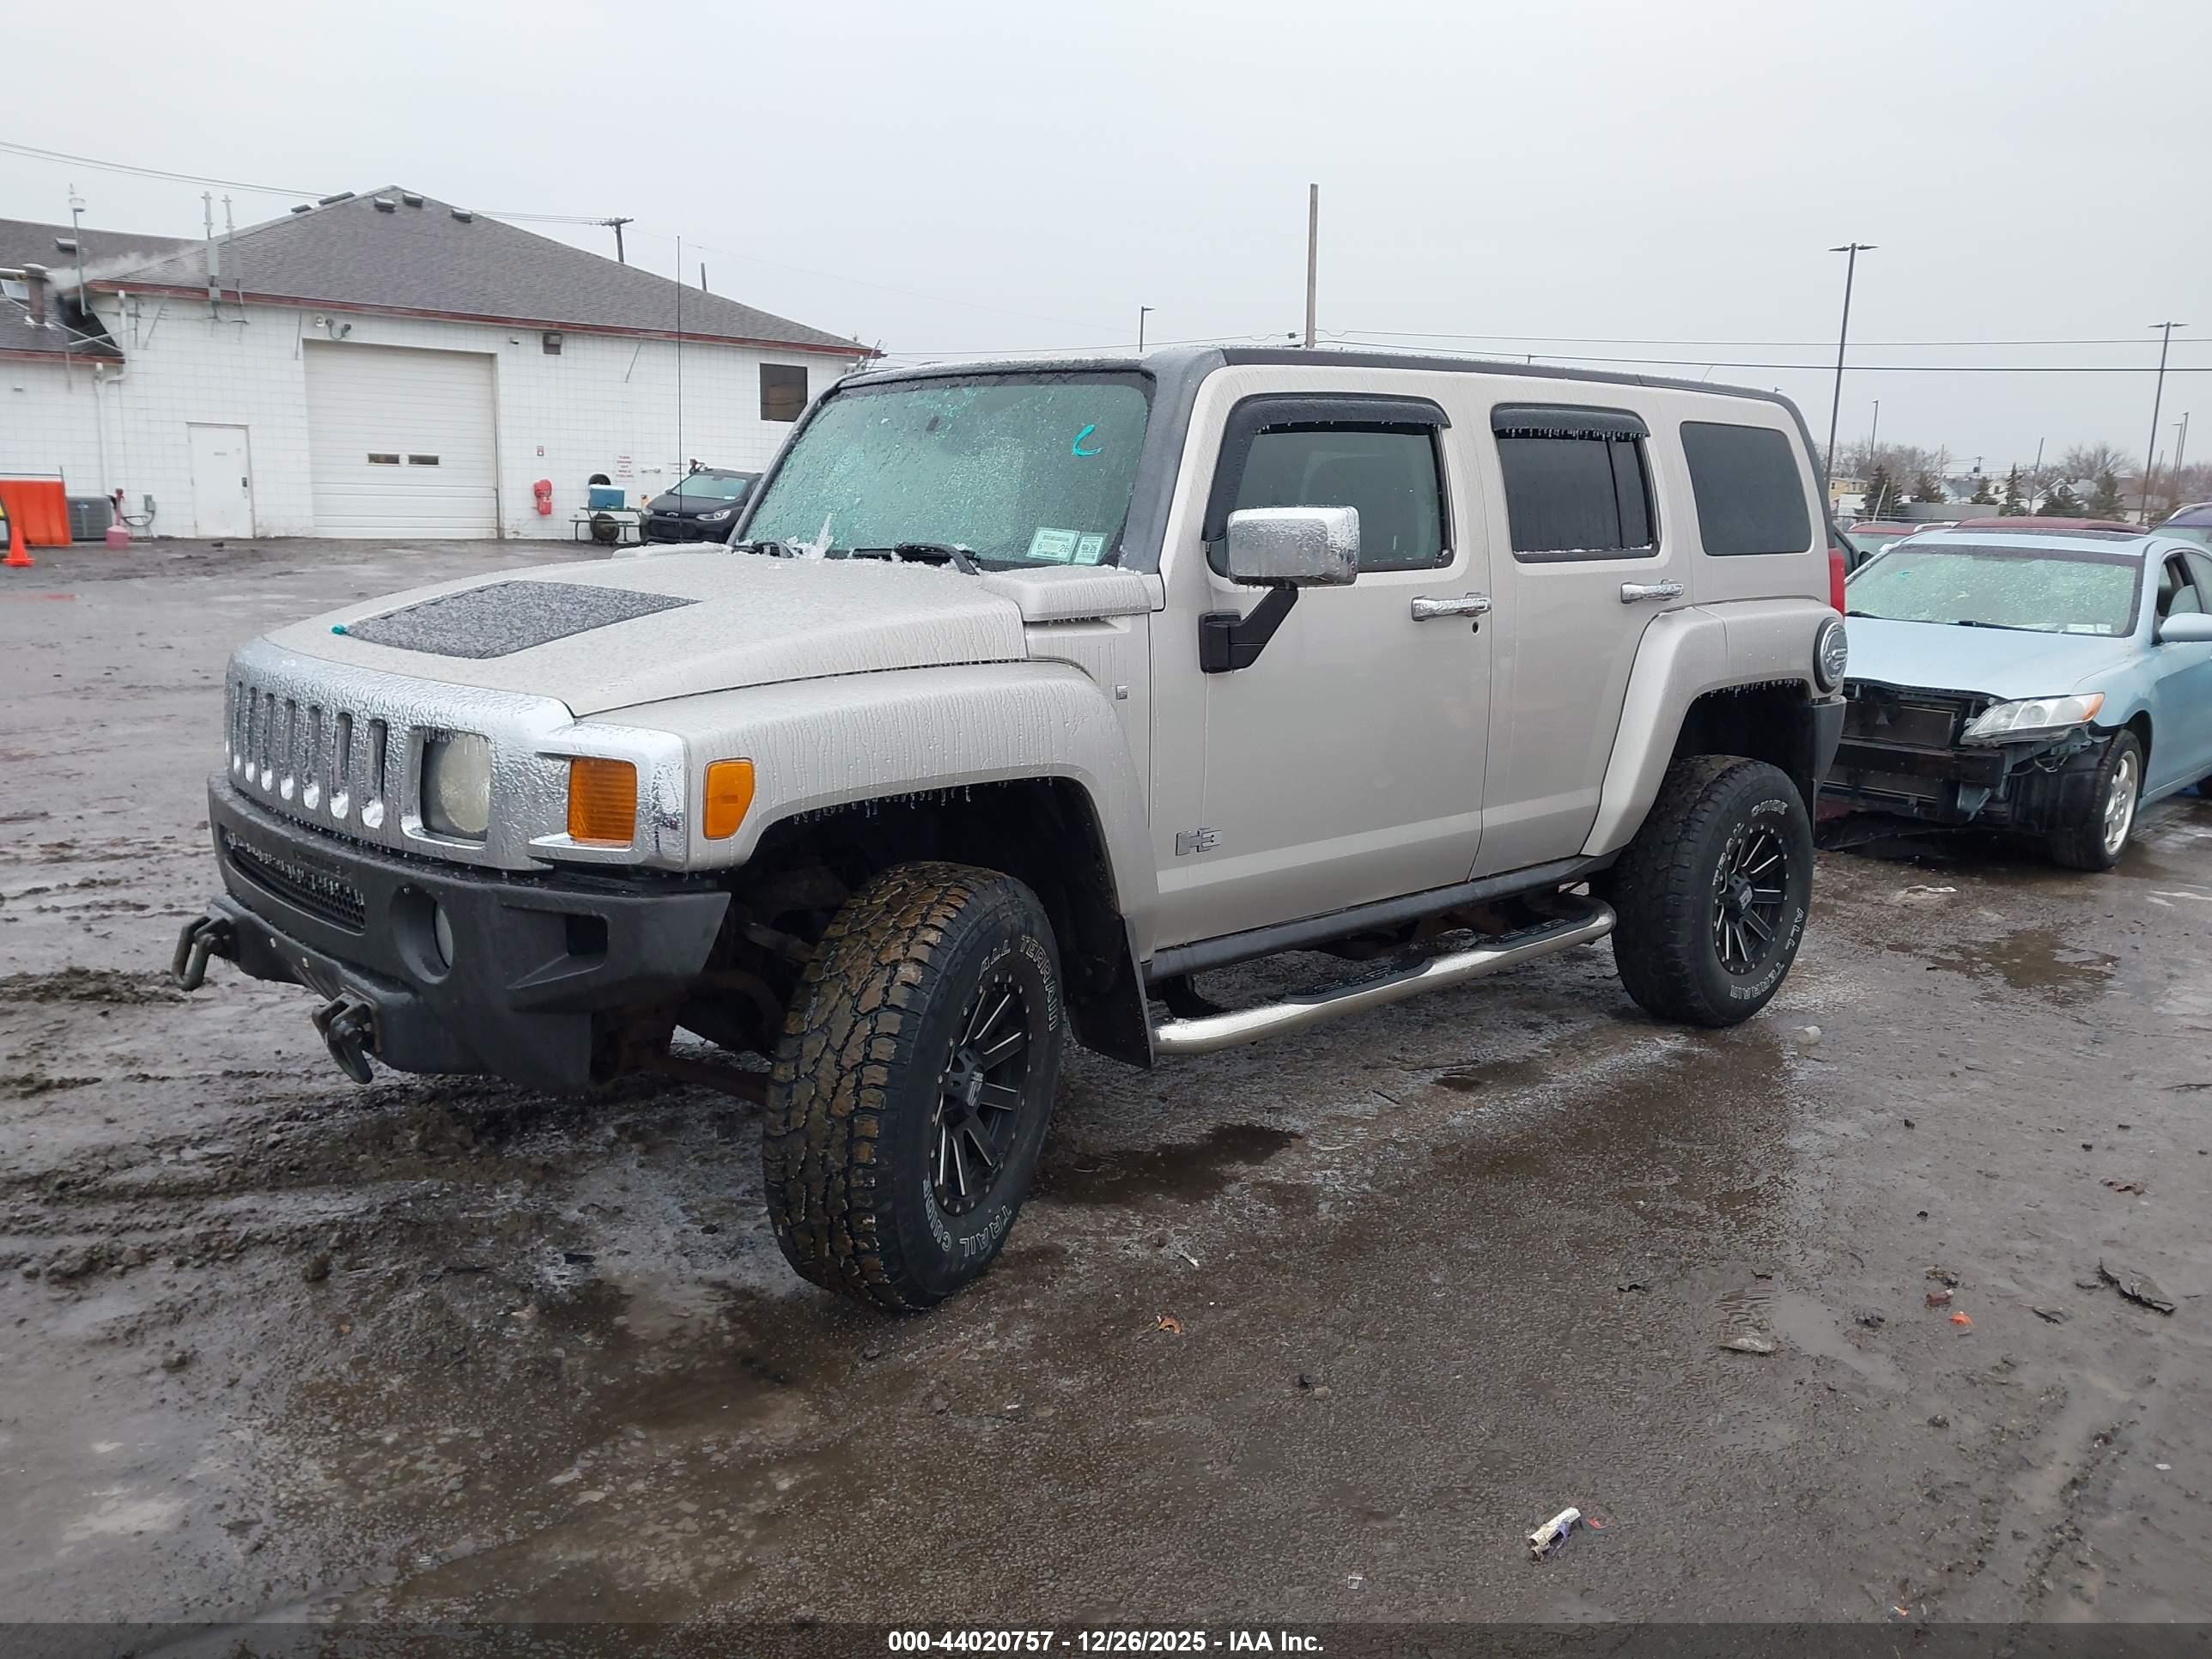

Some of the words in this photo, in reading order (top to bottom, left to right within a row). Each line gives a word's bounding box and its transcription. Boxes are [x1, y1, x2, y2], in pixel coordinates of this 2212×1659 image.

[1176, 827, 1224, 857] H3
[1784, 907, 1806, 951] ALL
[977, 939, 1012, 981] ALL
[1020, 934, 1059, 1032] TERRAIN
[922, 1171, 952, 1252] GUIDE
[958, 1204, 1013, 1257] TRAIL
